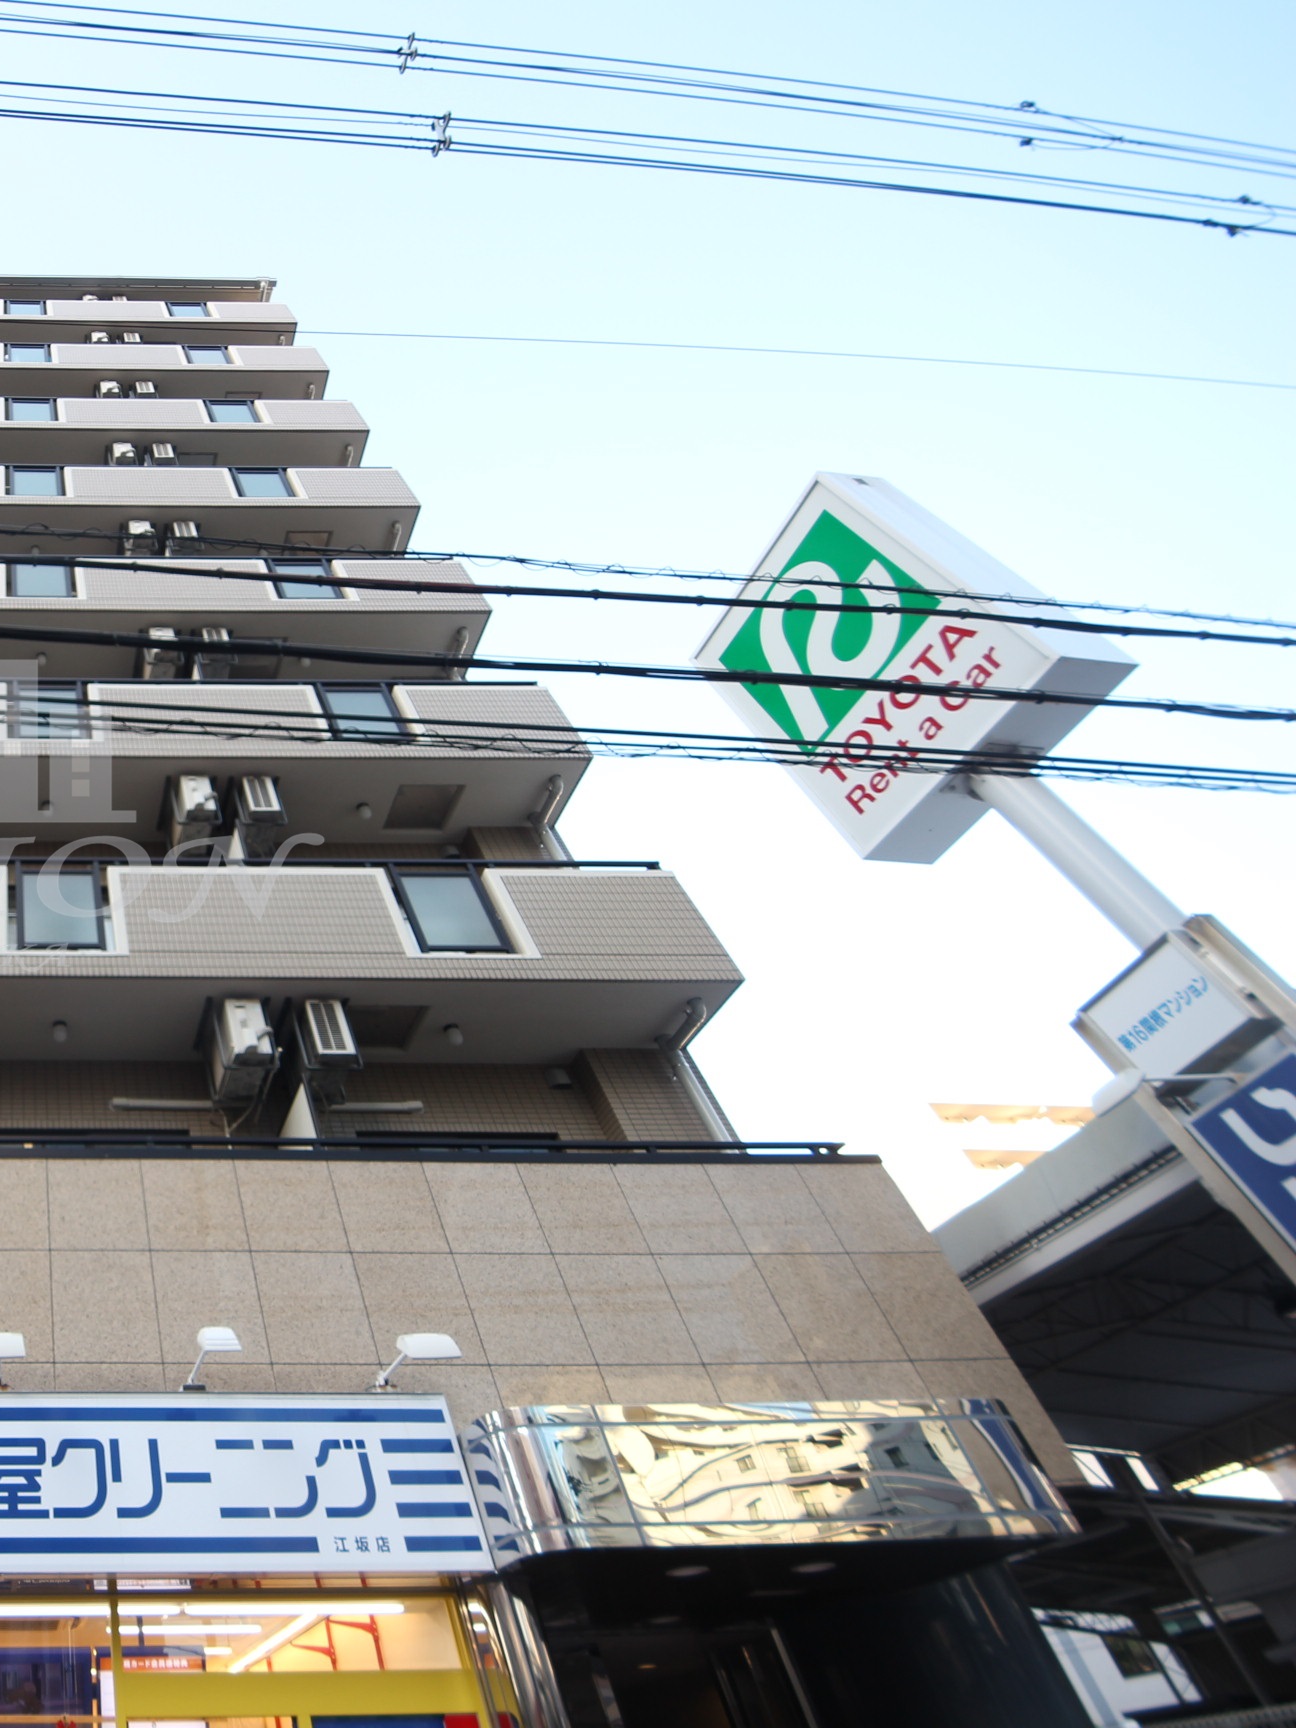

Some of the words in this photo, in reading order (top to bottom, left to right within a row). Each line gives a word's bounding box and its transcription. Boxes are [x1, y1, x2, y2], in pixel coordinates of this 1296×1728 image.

[819, 625, 978, 782] TOYOTA
[845, 739, 919, 815] Rent
[918, 716, 944, 741] a
[939, 646, 1001, 711] Car
[334, 1536, 391, 1552] 江坂店
